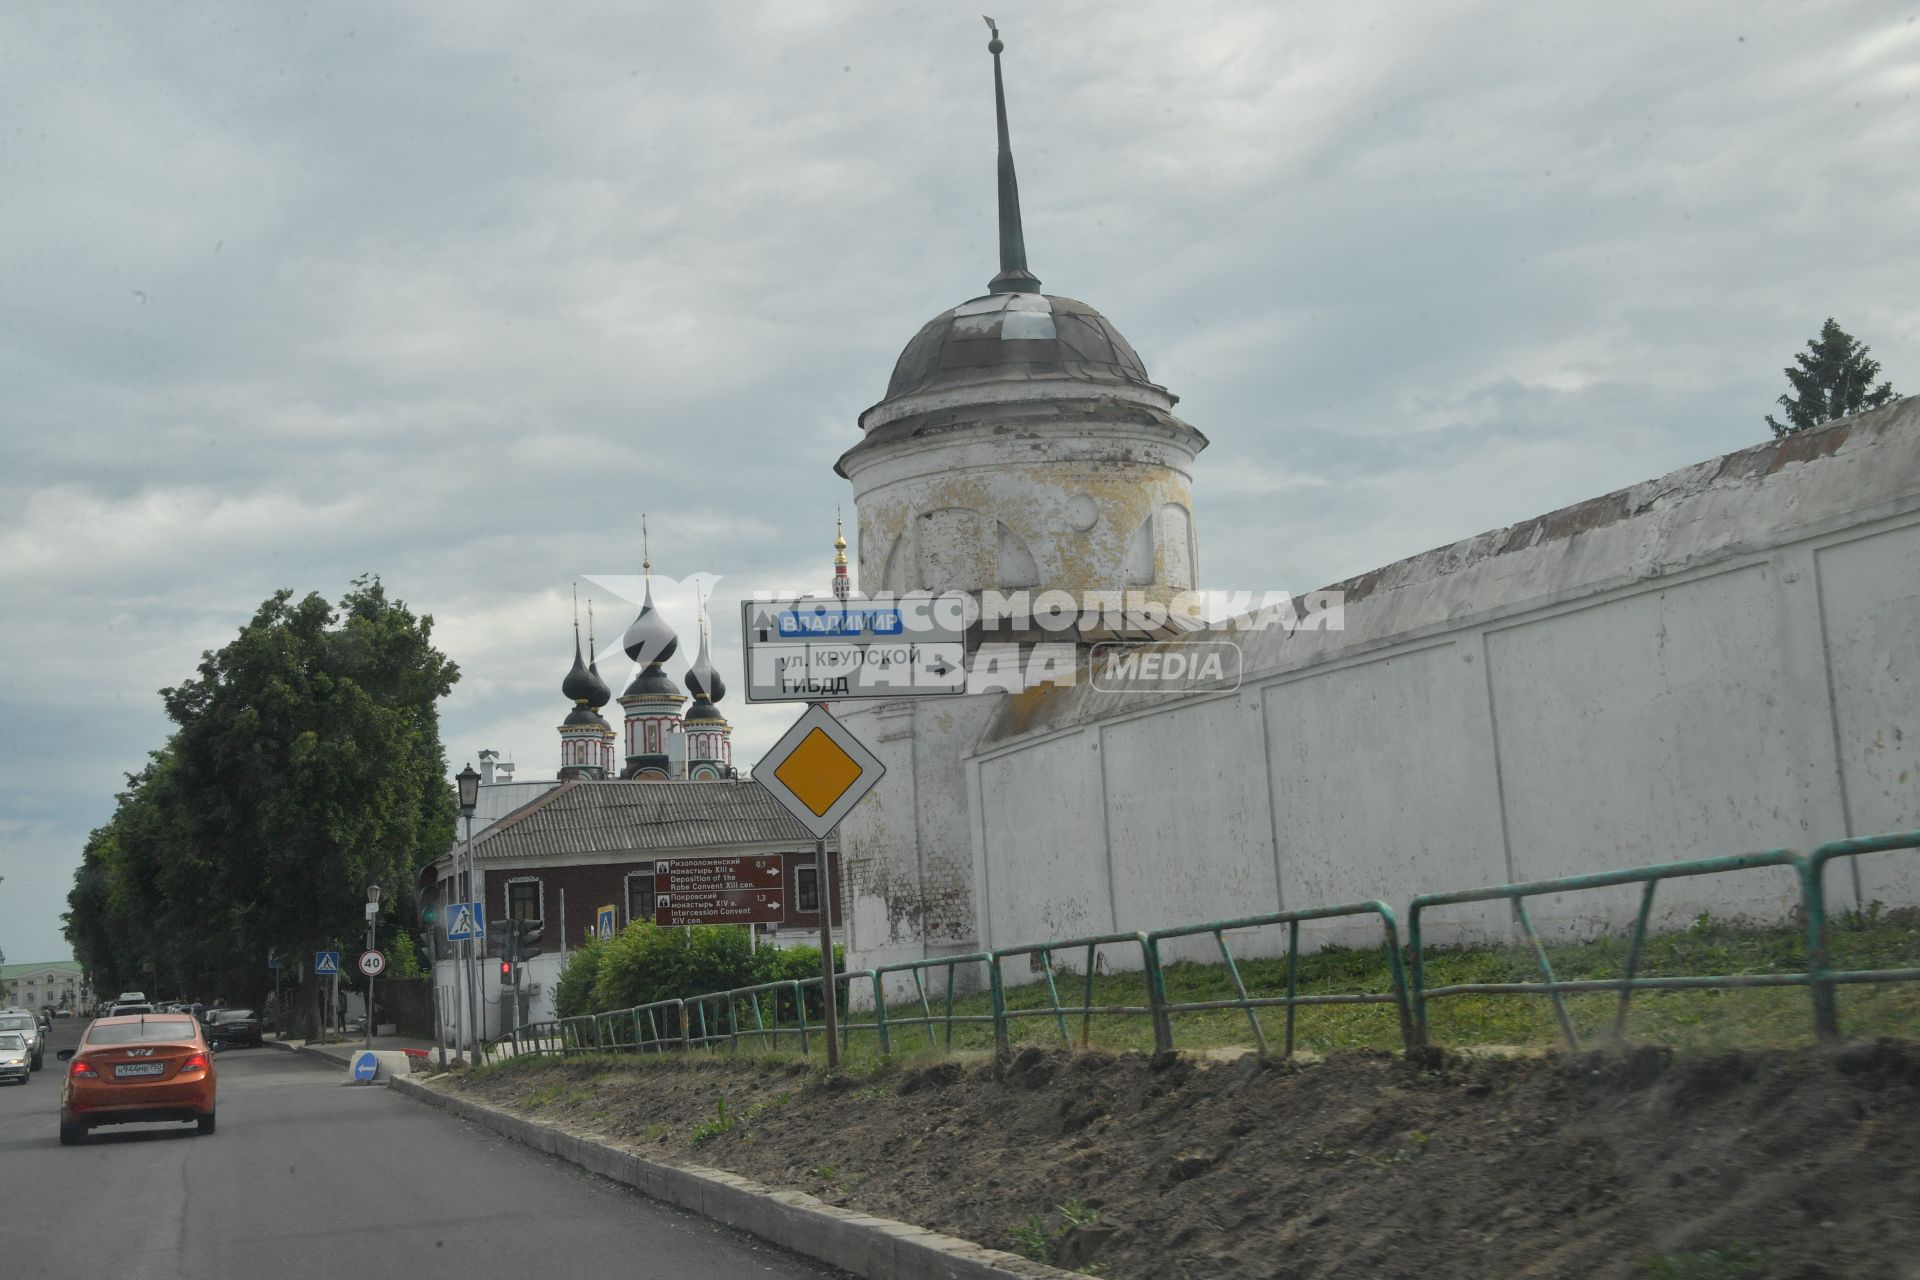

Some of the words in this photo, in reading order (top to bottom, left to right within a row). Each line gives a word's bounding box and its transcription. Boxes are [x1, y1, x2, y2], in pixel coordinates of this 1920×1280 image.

[783, 613, 898, 634] ВЛАДИМИР
[781, 655, 809, 672] ул.
[815, 645, 921, 668] КРУПСКОЙ
[782, 676, 849, 694] ГИБДД
[670, 859, 740, 867] Ризоположенский
[755, 860, 766, 868] 0,1
[670, 875, 710, 883] Deposition
[670, 883, 690, 891] Robe
[692, 882, 723, 890] Convent
[725, 881, 738, 889] XIII
[671, 892, 718, 901] Покровский
[756, 894, 766, 902] 1,3
[671, 901, 713, 909] монастырь
[671, 909, 718, 917] Intercession
[720, 907, 751, 915] Convent
[671, 917, 685, 925] XIV
[364, 958, 380, 968] 40
